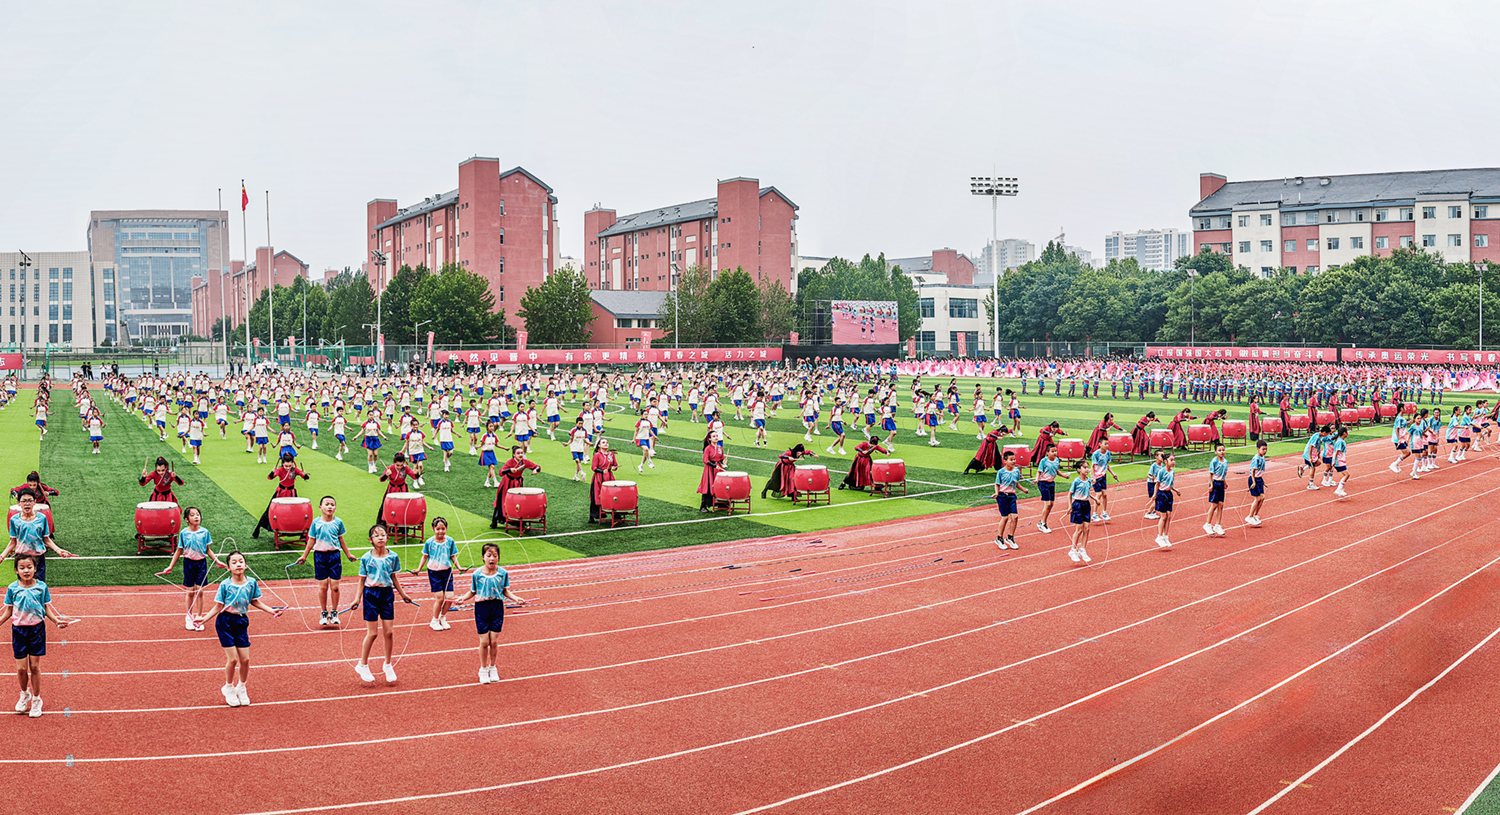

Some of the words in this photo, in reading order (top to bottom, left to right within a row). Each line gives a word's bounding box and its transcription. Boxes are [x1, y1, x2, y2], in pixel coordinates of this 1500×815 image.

[565, 351, 646, 361] 有你更精彩
[663, 351, 709, 360] 青春之城
[725, 350, 767, 359] 活力之城
[1446, 352, 1496, 362] 书写青春
